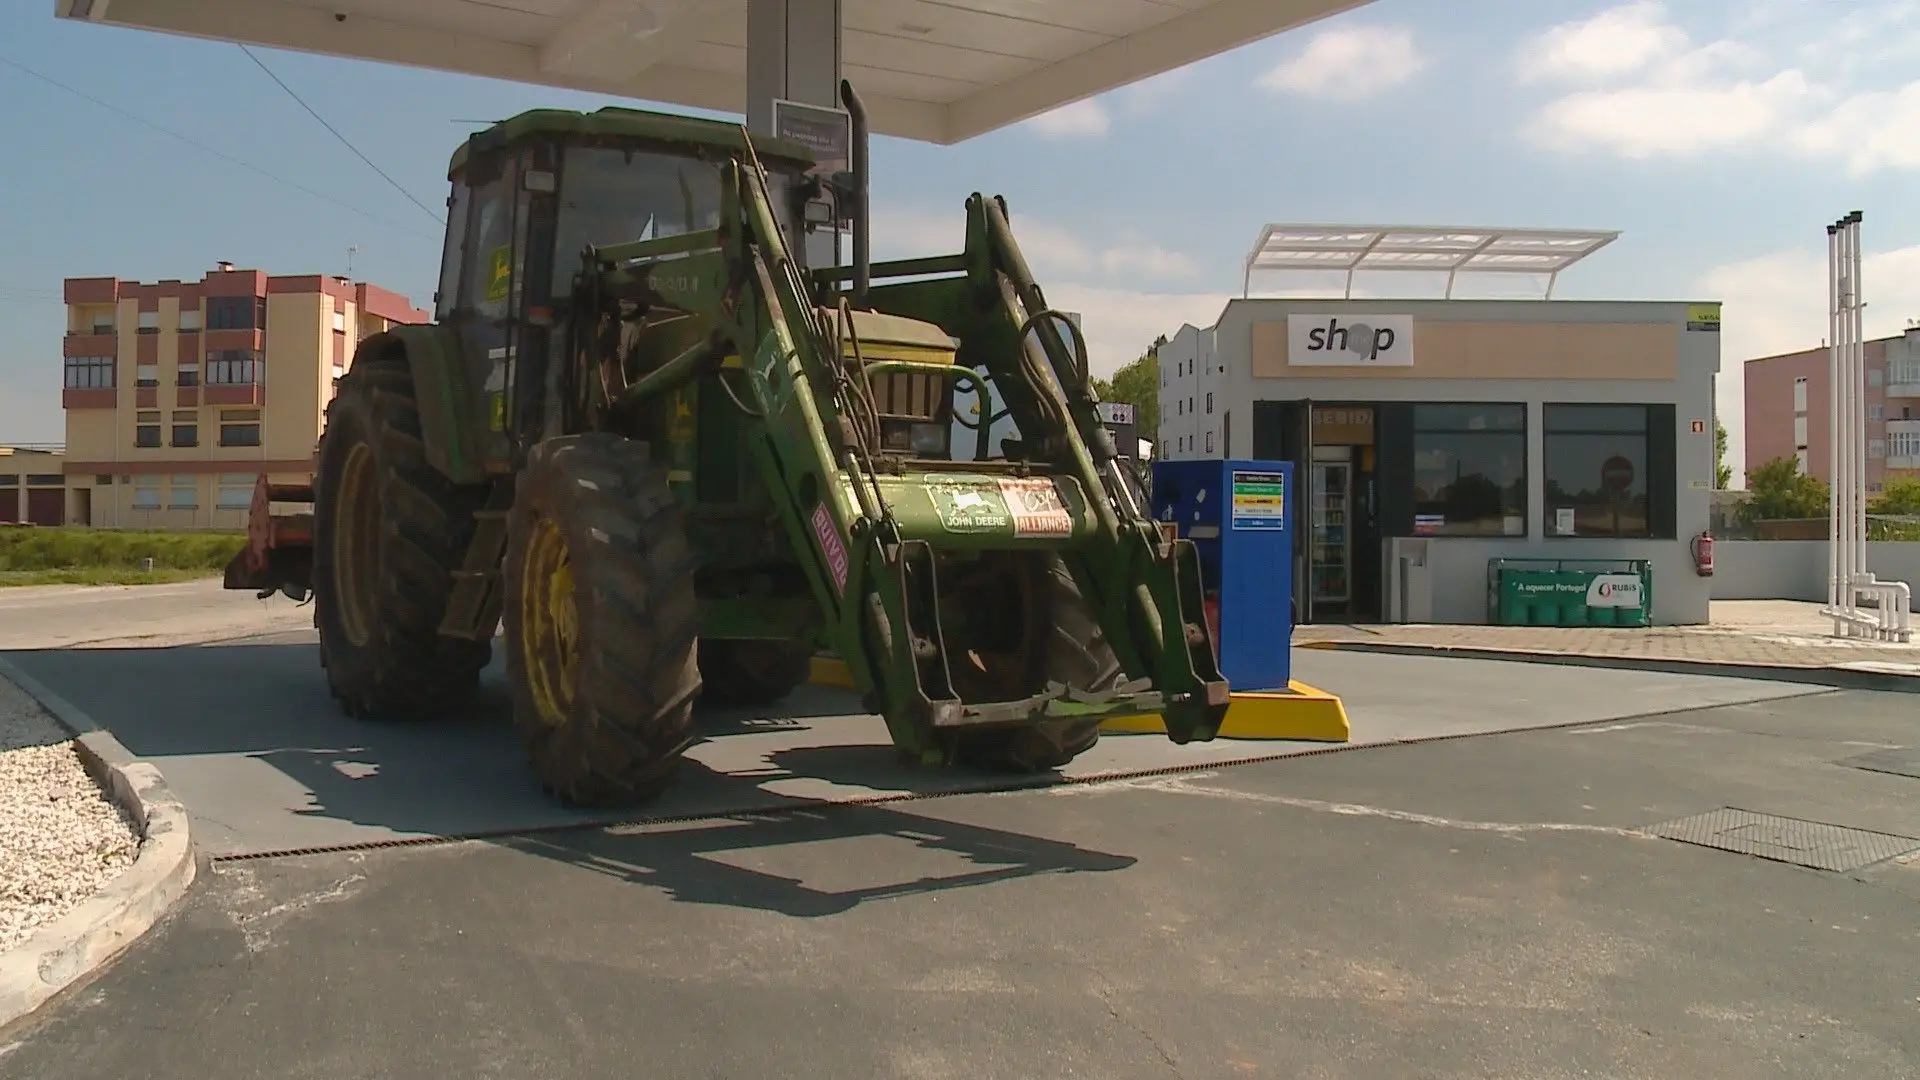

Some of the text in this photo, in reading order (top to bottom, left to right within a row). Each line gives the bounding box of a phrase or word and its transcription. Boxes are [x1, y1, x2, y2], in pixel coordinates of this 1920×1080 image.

[1308, 318, 1395, 360] shop
[947, 516, 1007, 527] JOHN DEERE
[1018, 516, 1070, 533] ALLIANCE
[1526, 584, 1554, 593] aquecer
[1555, 583, 1587, 593] Portugal
